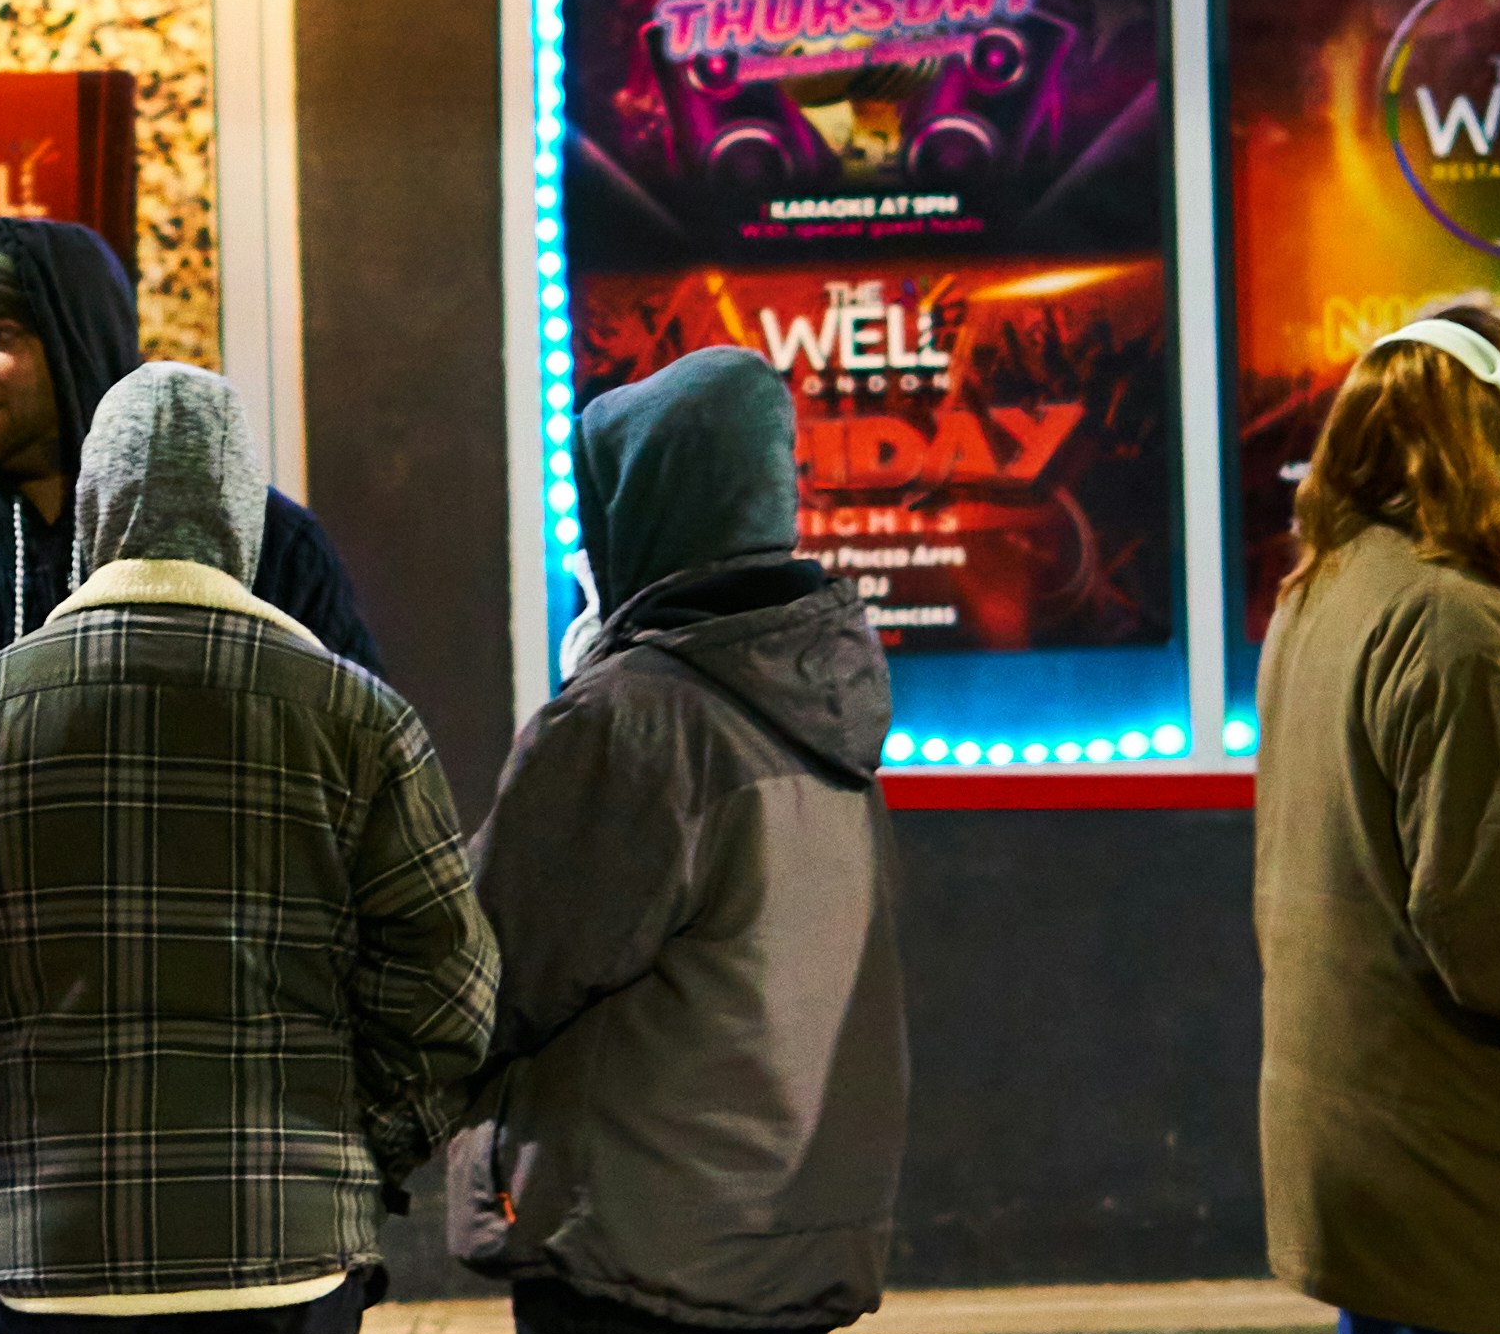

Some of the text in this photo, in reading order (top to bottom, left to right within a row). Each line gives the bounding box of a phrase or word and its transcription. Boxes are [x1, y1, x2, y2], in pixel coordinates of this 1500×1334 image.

[769, 197, 876, 219] KARAOKE
[878, 196, 909, 216] AT
[824, 281, 884, 306] THE
[759, 305, 950, 372] WELL
[795, 401, 1085, 488] IDAY
[858, 575, 890, 598] DJ
